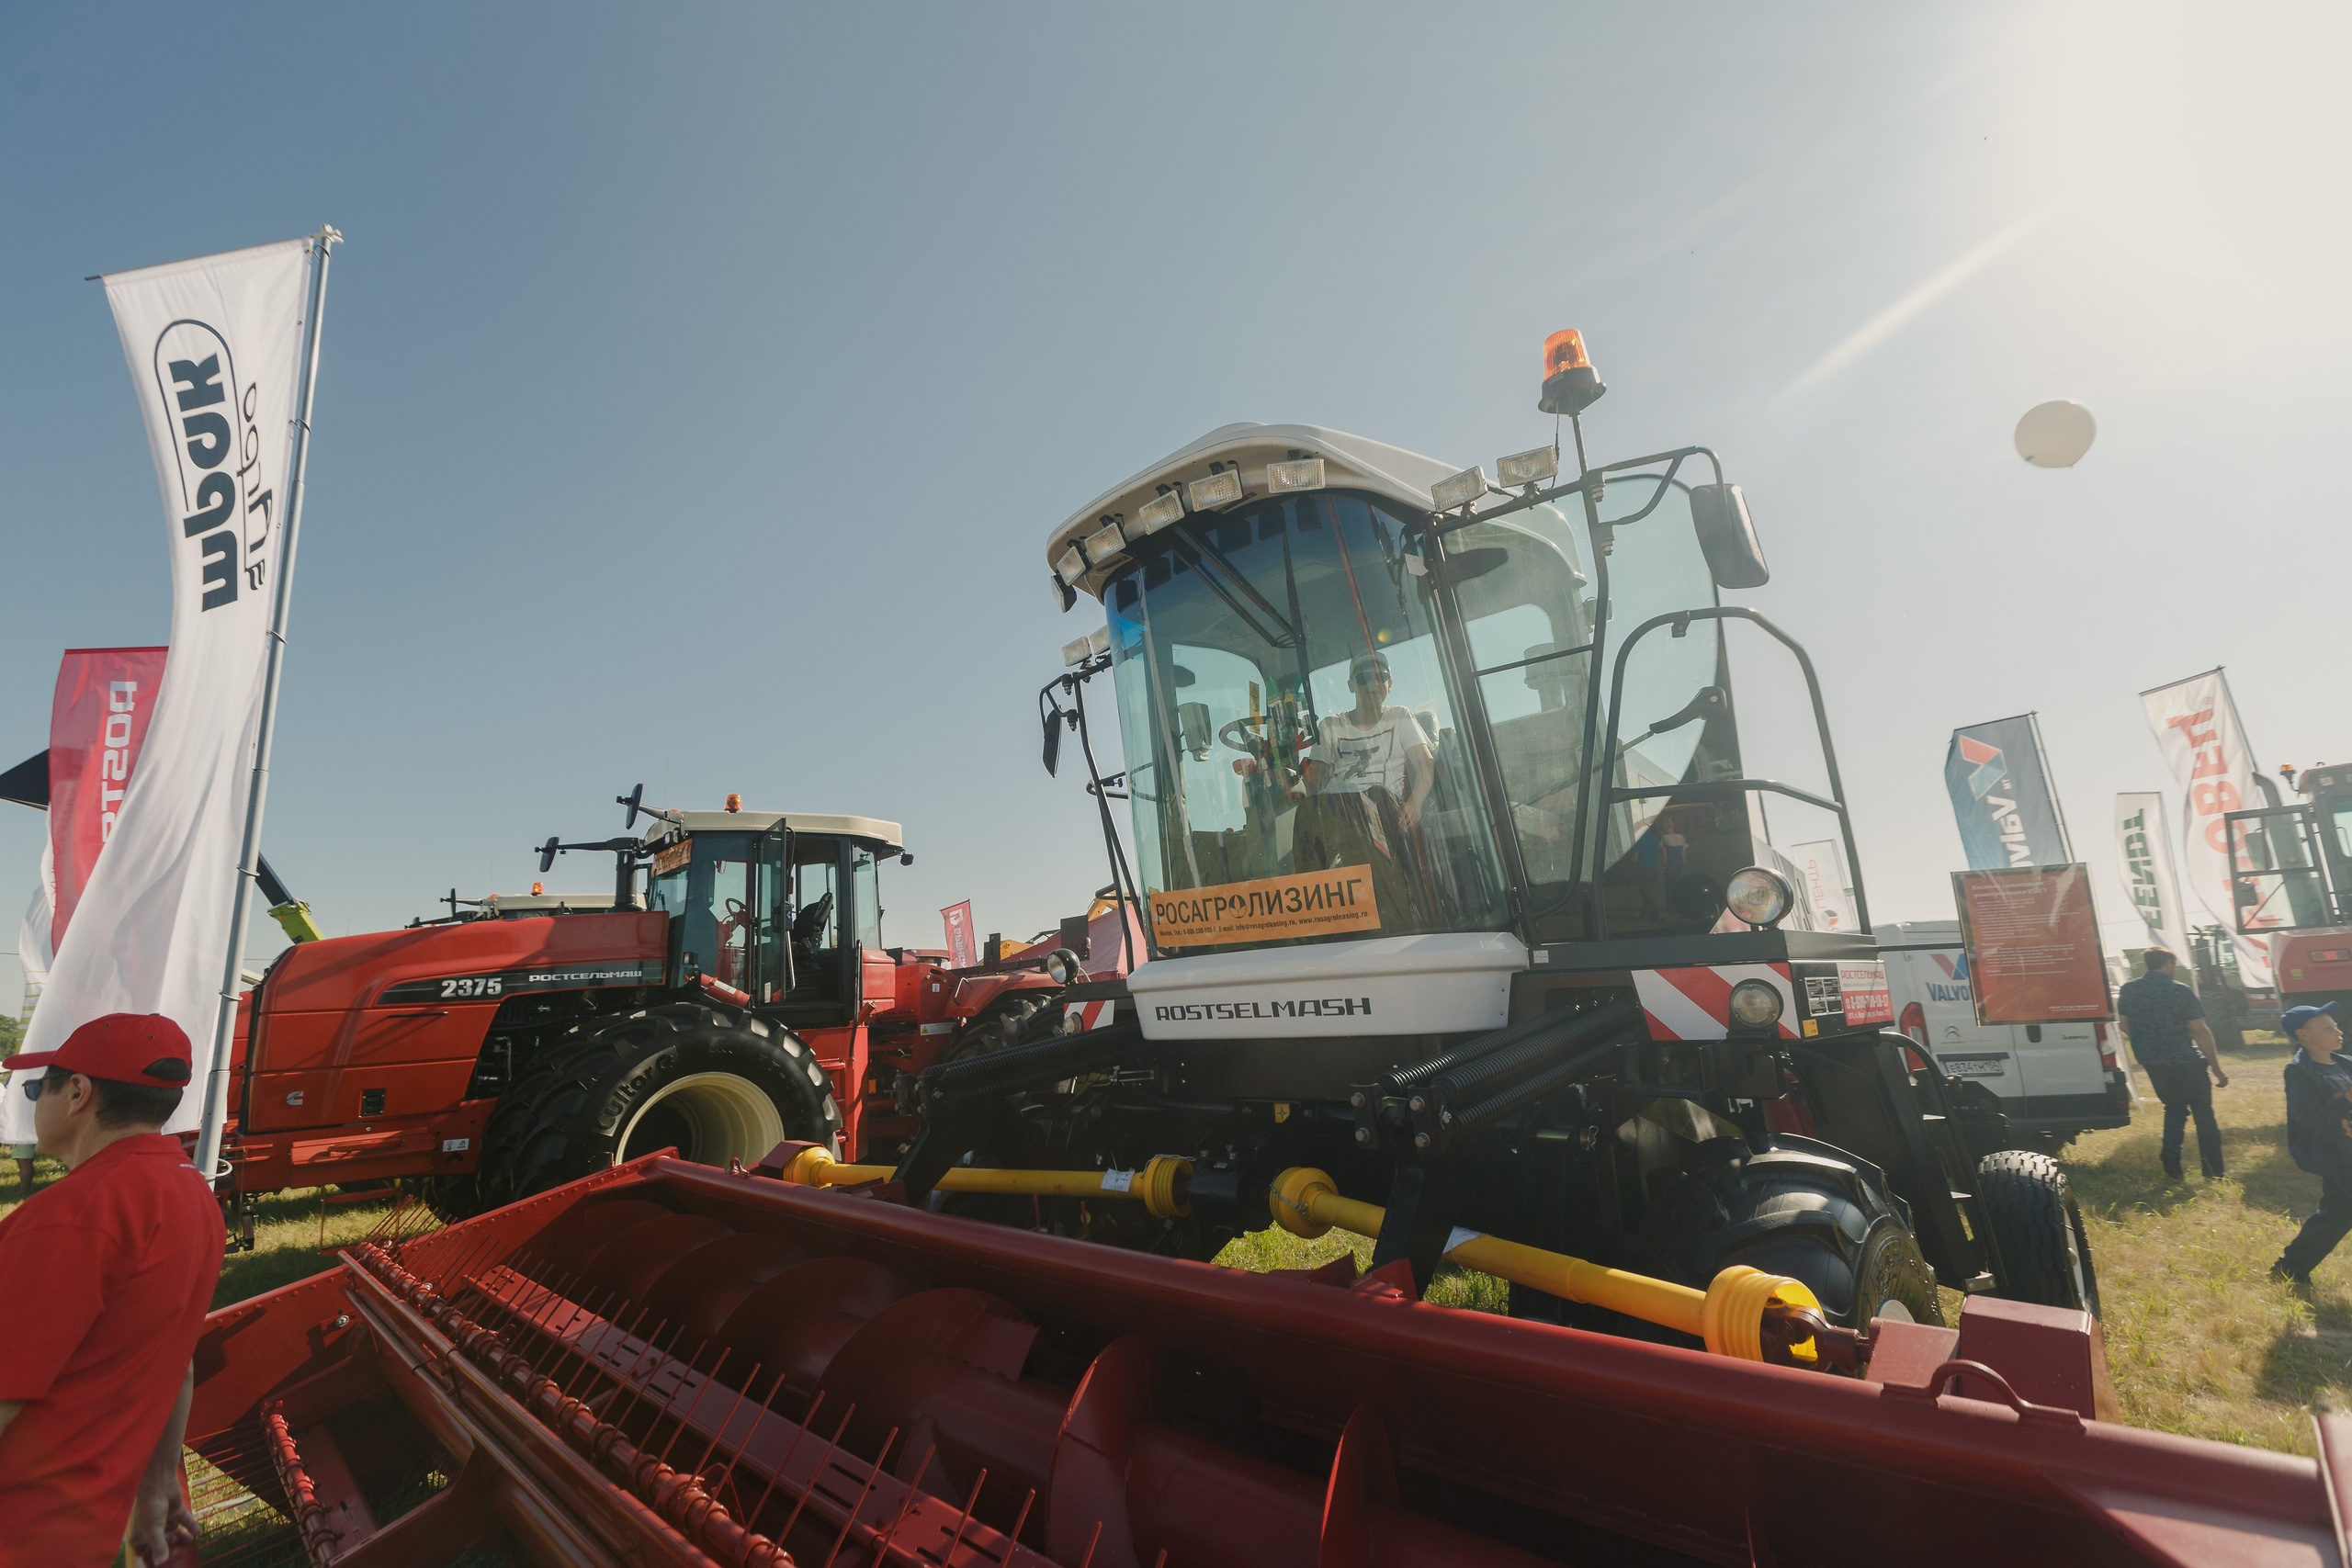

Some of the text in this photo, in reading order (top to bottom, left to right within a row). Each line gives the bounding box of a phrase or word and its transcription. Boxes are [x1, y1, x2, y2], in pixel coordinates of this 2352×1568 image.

[1298, 911, 1368, 925] www.rosagroleasing.ru
[529, 970, 642, 982] РОСТСЕЛЬМАШ
[440, 977, 503, 998] 2375
[1926, 982, 1972, 1001] VALVO
[1155, 998, 1372, 1021] ROSTSELMASH
